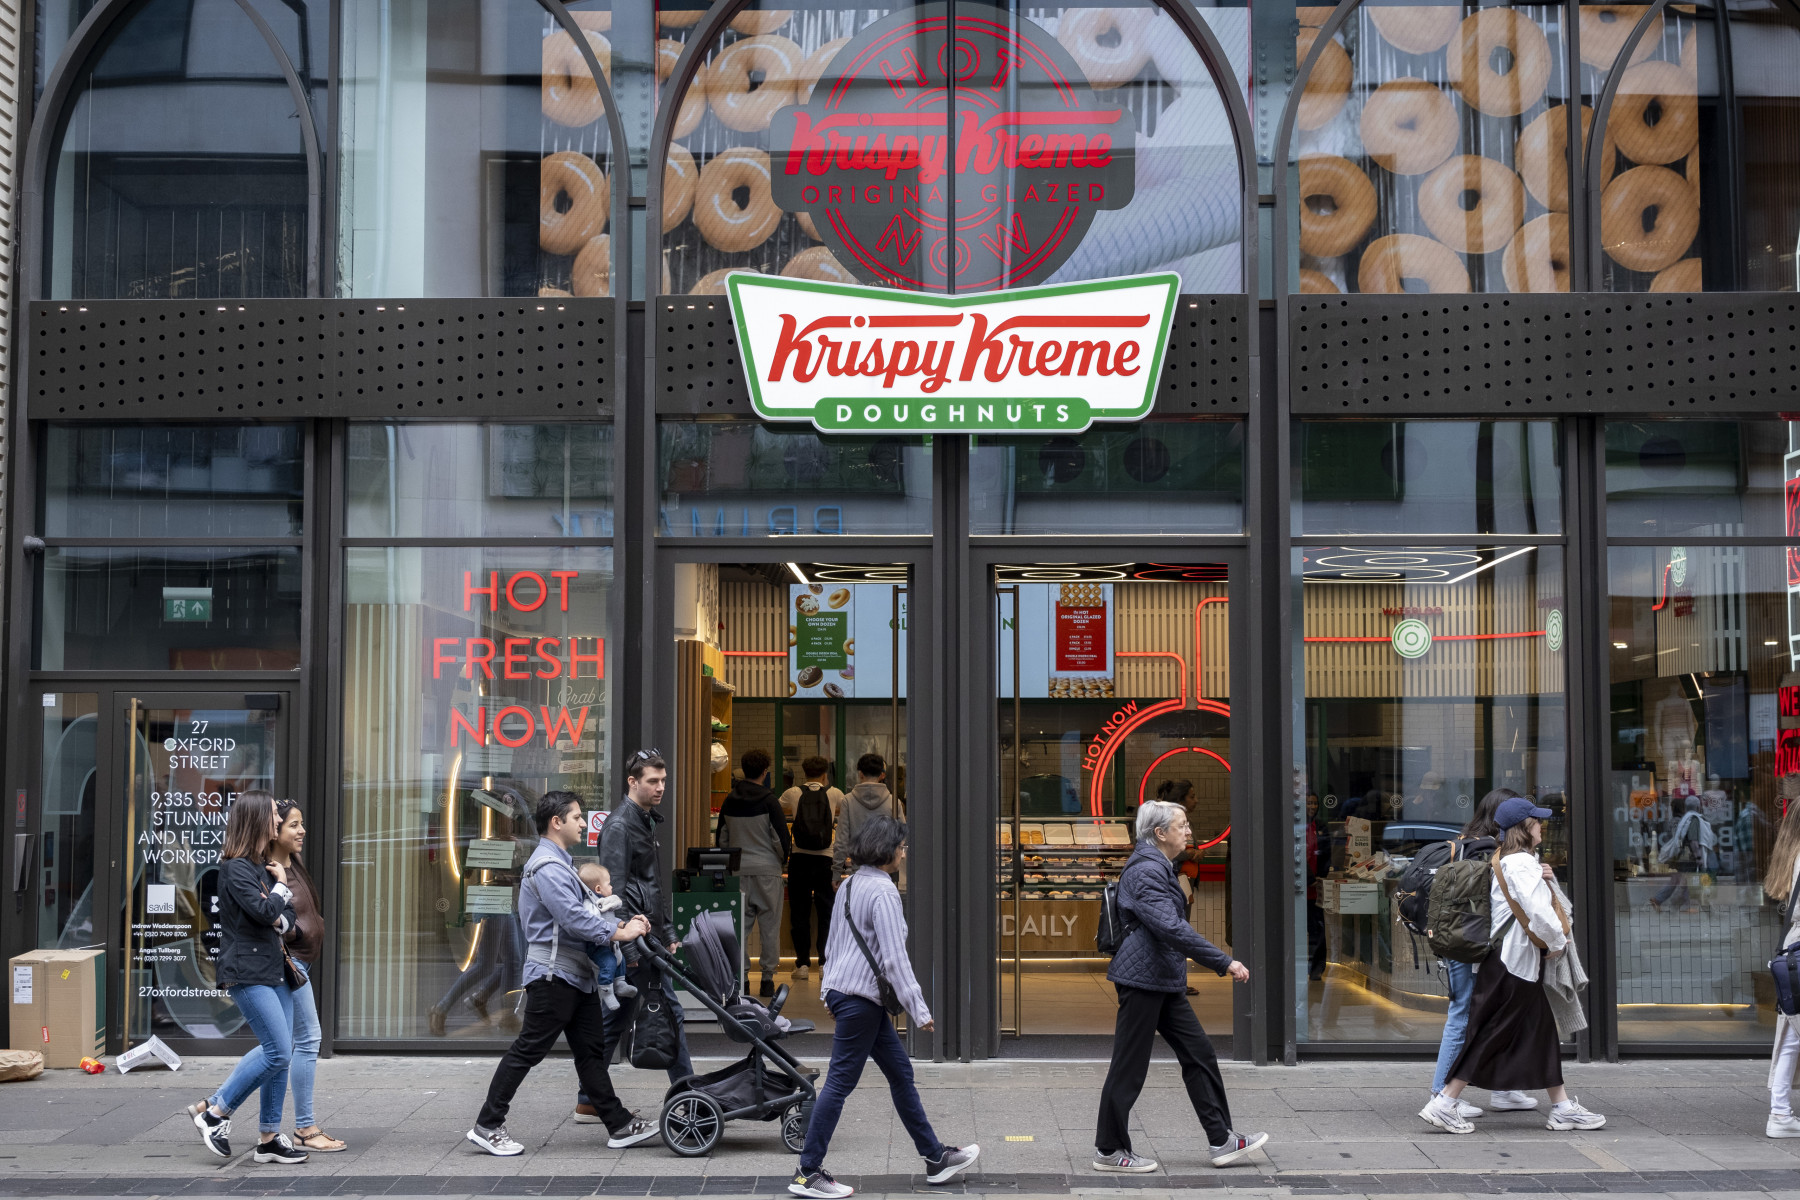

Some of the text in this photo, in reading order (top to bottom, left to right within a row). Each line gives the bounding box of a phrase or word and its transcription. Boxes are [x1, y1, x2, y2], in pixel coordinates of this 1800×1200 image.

[880, 37, 1025, 99] HOT
[784, 108, 1122, 184] Krispy Kreme
[981, 183, 1106, 203] GLAZED
[875, 213, 1031, 278] NOW
[767, 312, 1151, 393] Krispy Kreme
[836, 403, 1071, 423] DOUGHNUTS
[463, 570, 579, 612] HOT
[1382, 606, 1443, 617] WATERLOO
[432, 637, 605, 680] FRESH
[558, 685, 596, 706] Grab
[191, 720, 209, 735] 27
[450, 705, 589, 748] NOW
[1082, 699, 1139, 772] HOT NOW
[163, 737, 236, 752] OXFORD
[169, 755, 230, 769] STREET
[151, 791, 193, 809] 9,335
[197, 791, 223, 807] SQ
[153, 811, 229, 826] STUNNIN
[138, 830, 226, 845] AND FLEXI
[148, 902, 174, 912] savills
[1002, 914, 1079, 937] DAILY
[138, 986, 232, 998] 27oxfordstreet.c
